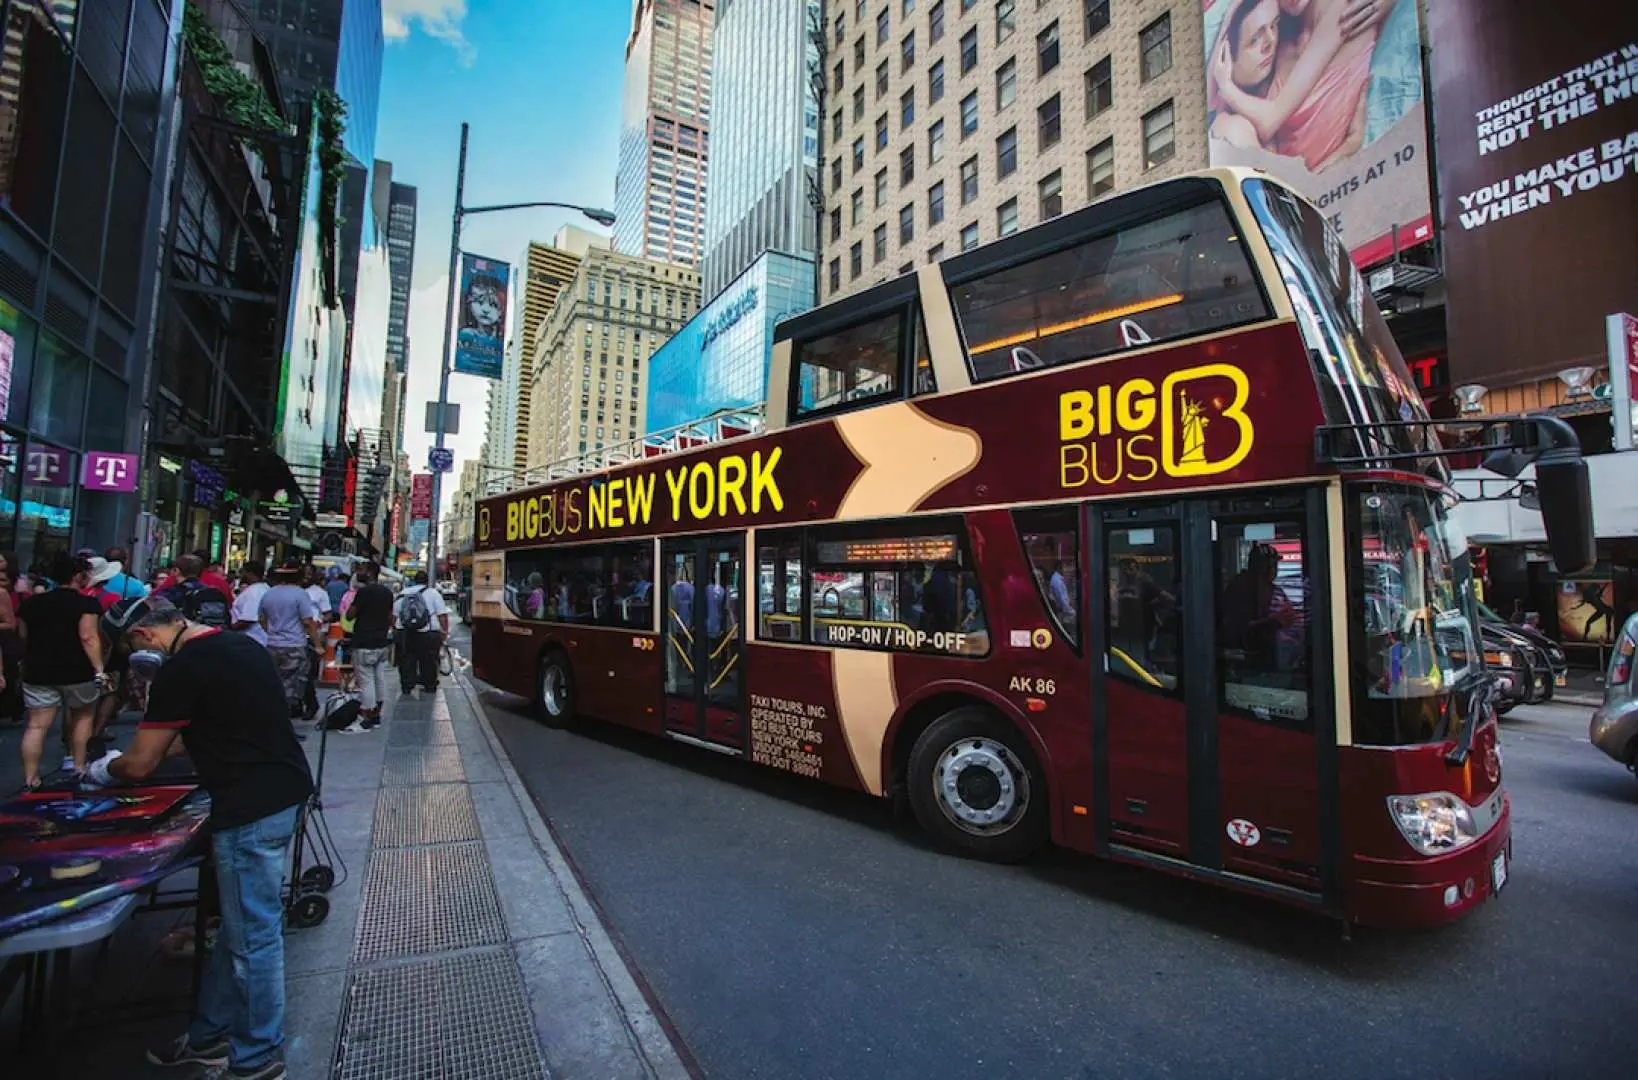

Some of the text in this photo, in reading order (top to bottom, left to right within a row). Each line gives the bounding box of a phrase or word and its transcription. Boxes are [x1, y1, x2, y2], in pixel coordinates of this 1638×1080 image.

[1476, 77, 1561, 122] THOUGHT
[1563, 52, 1617, 83] THAT
[1477, 57, 1638, 137] RENT FOR THE
[1479, 119, 1534, 155] NOT
[1538, 92, 1598, 129] THE
[1365, 160, 1386, 184] AT
[1394, 144, 1415, 166] 10
[1458, 179, 1510, 210] YOU
[1515, 147, 1596, 192] MAKE
[1459, 151, 1638, 230] WHEN YOU'
[1059, 377, 1157, 441] BIG
[588, 471, 657, 530] NEW
[665, 446, 785, 522] YORK
[1060, 435, 1158, 488] BUS
[828, 625, 881, 645] HOP-ON
[895, 628, 967, 651] HOP-OFF
[751, 694, 770, 707] TAXI
[1009, 675, 1056, 695] AK 86
[751, 707, 814, 730] OPERATED BY
[751, 718, 823, 744] BIG BUS TOURS
[752, 730, 800, 749] NEW YORK
